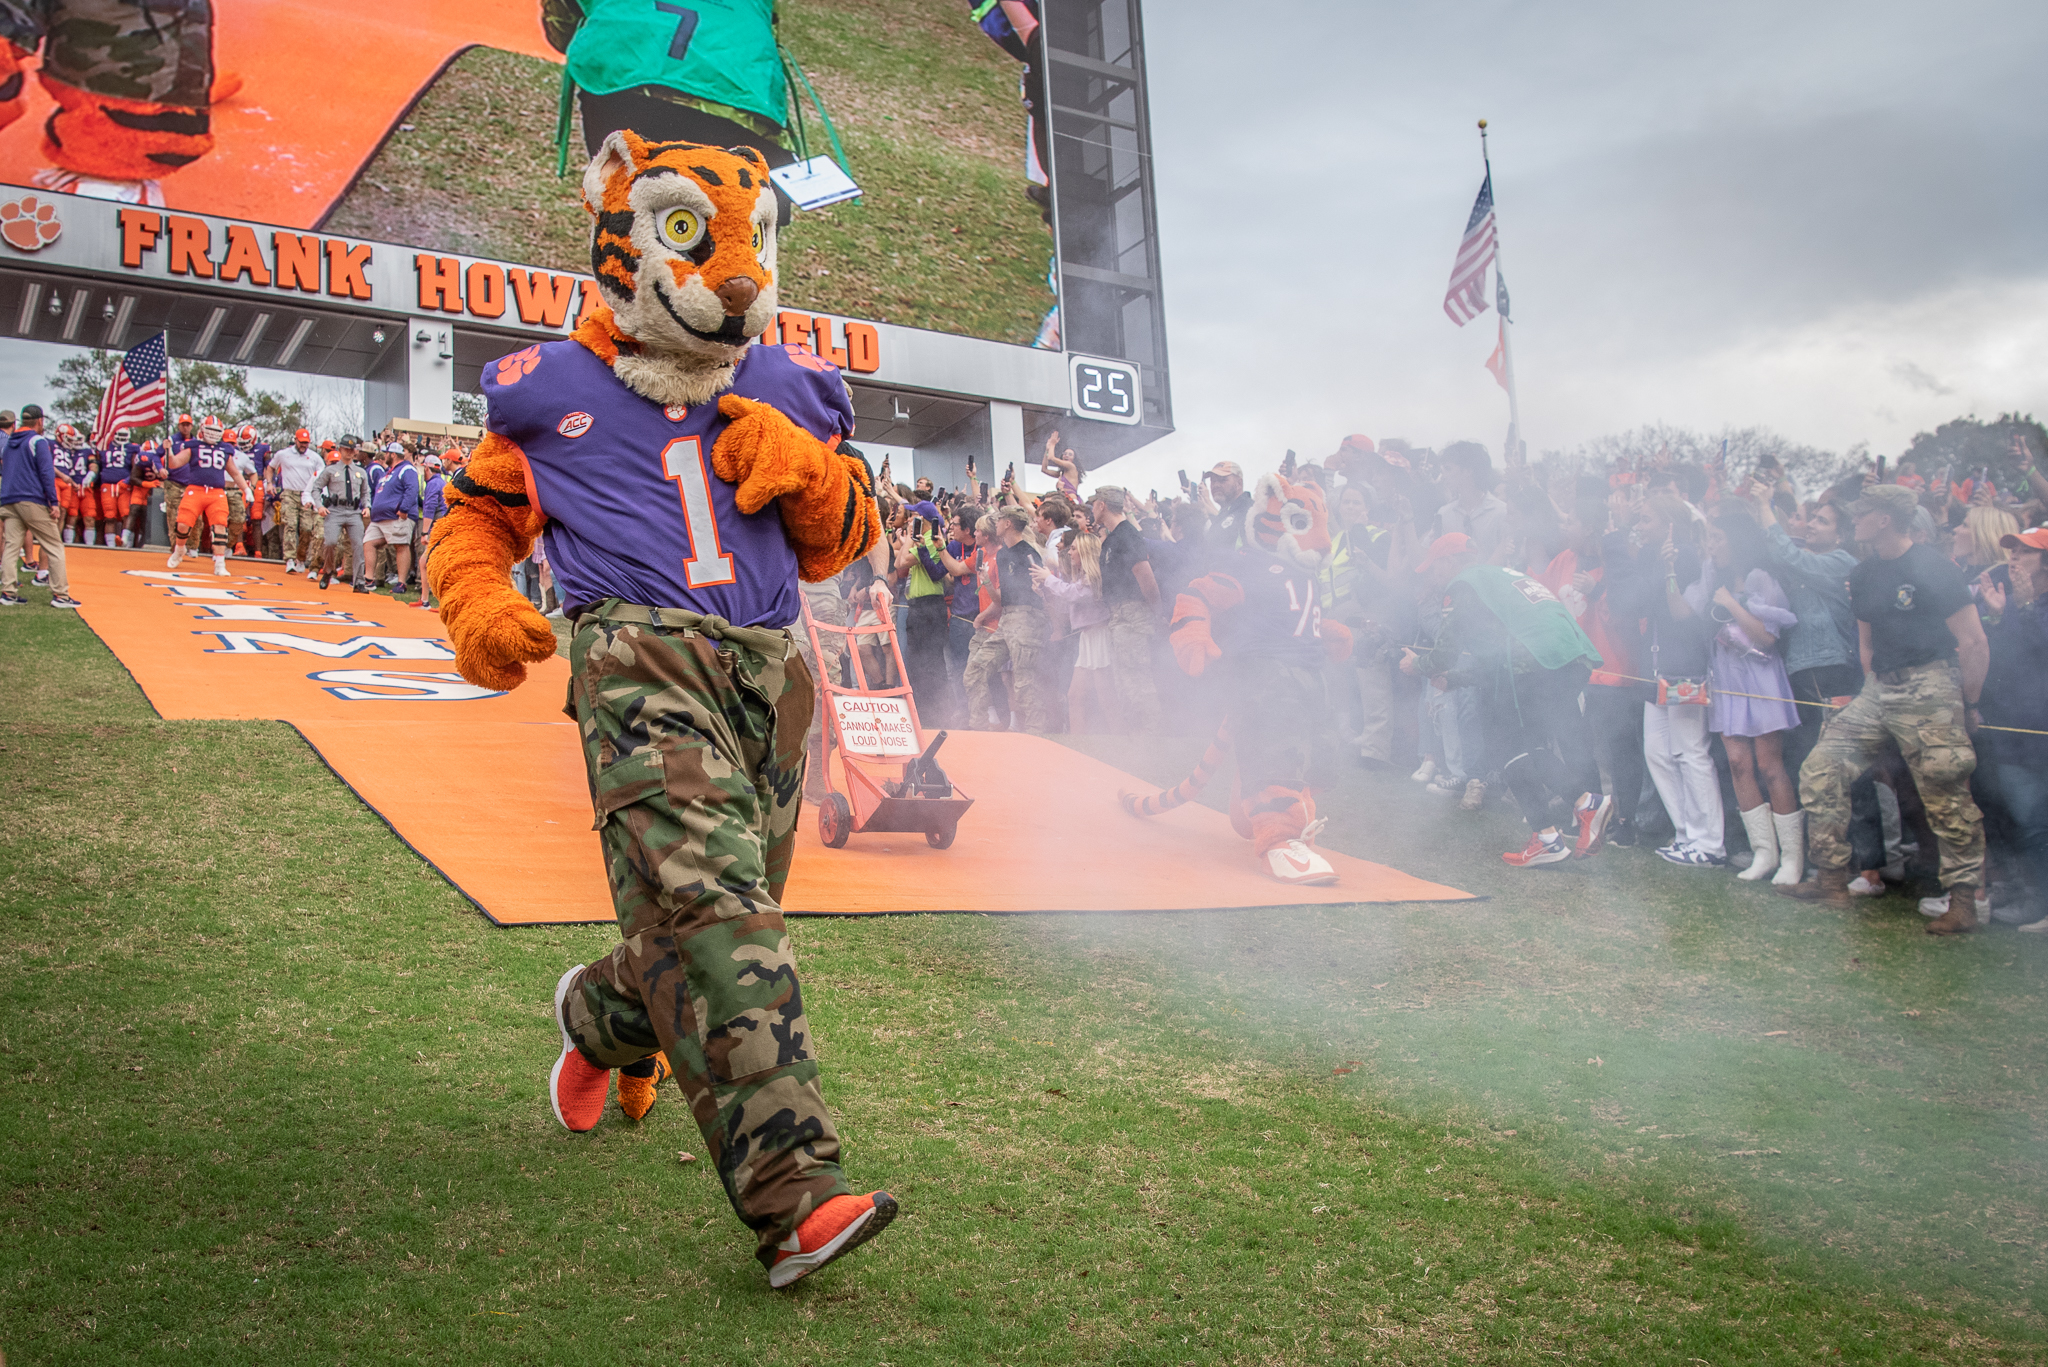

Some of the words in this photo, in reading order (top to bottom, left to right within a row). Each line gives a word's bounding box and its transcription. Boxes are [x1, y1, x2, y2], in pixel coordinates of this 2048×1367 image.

[654, 0, 699, 61] 7
[118, 207, 373, 300] FRANK
[415, 254, 613, 328] HOWA
[1083, 368, 1129, 413] 25
[564, 415, 587, 431] ACC
[53, 448, 73, 469] 25
[106, 450, 126, 468] 13
[198, 448, 226, 470] 56
[660, 434, 736, 589] 1
[842, 701, 900, 713] CAUTION
[839, 720, 879, 732] CANNON
[880, 722, 913, 733] MAKES
[852, 735, 877, 746] LOUD
[880, 736, 908, 747] NOISE
